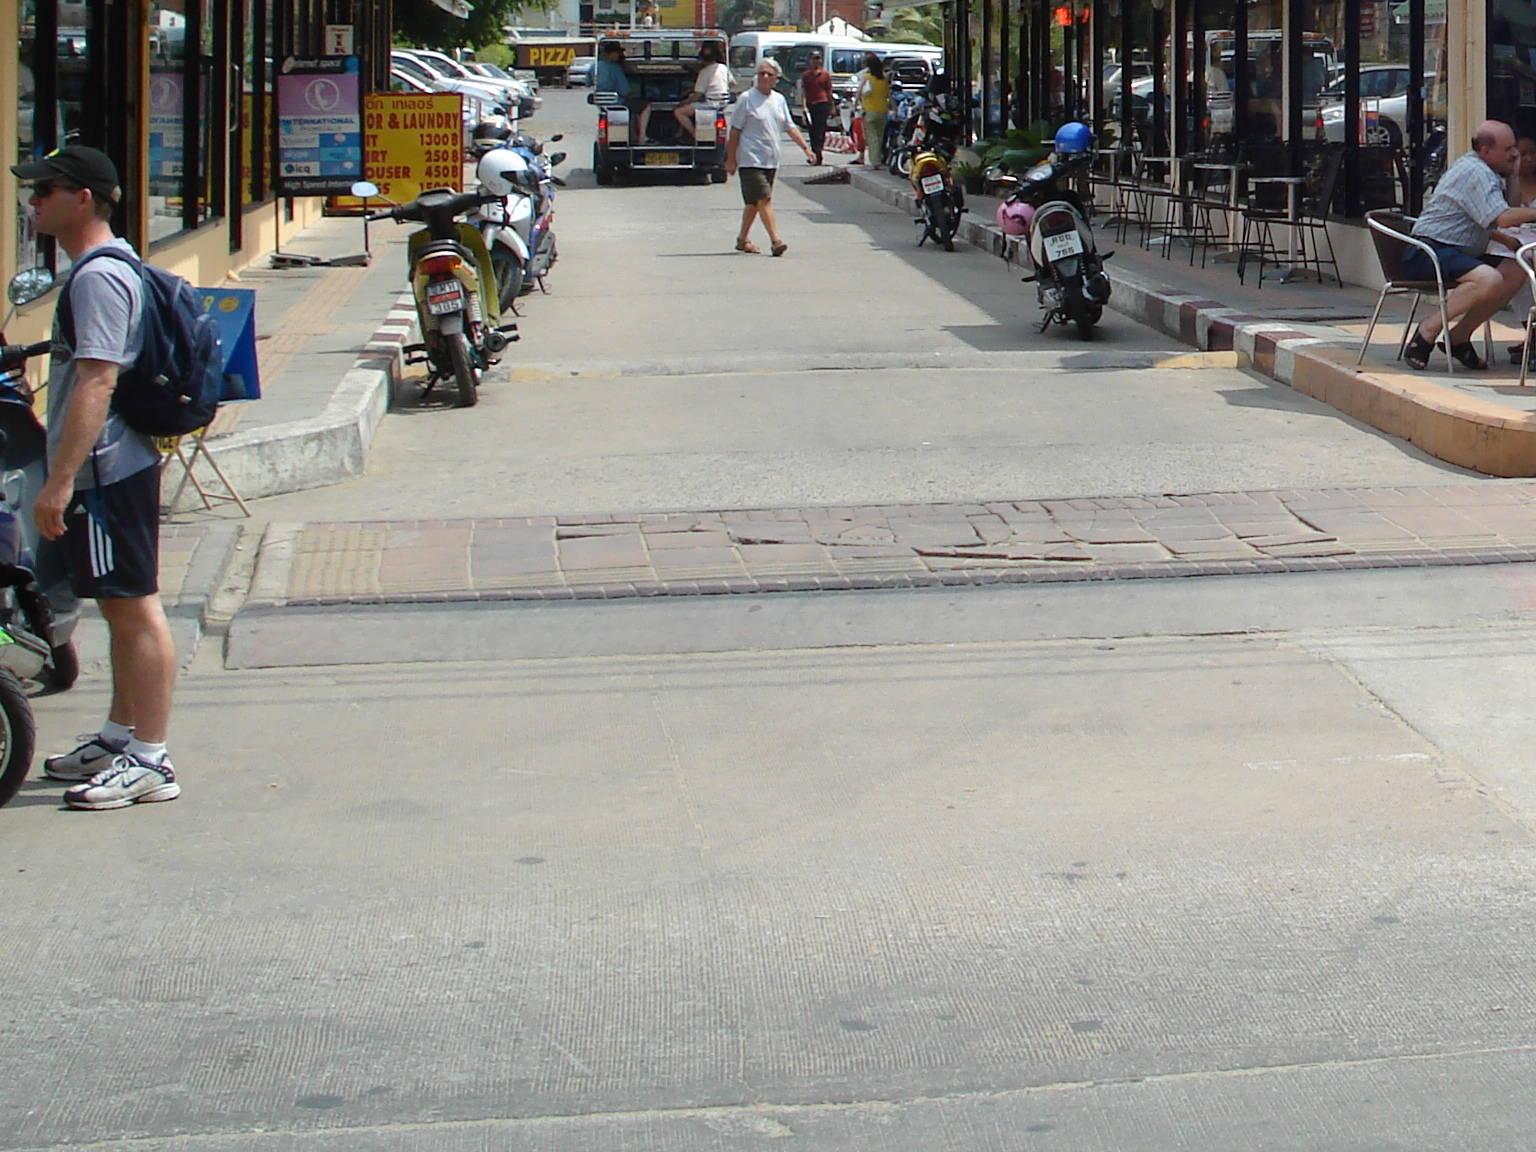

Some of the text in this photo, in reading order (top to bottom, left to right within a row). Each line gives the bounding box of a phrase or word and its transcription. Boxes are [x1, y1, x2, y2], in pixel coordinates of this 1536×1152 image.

[529, 47, 577, 66] PIZZA
[387, 113, 400, 129] &
[403, 113, 459, 129] LAUNDRY
